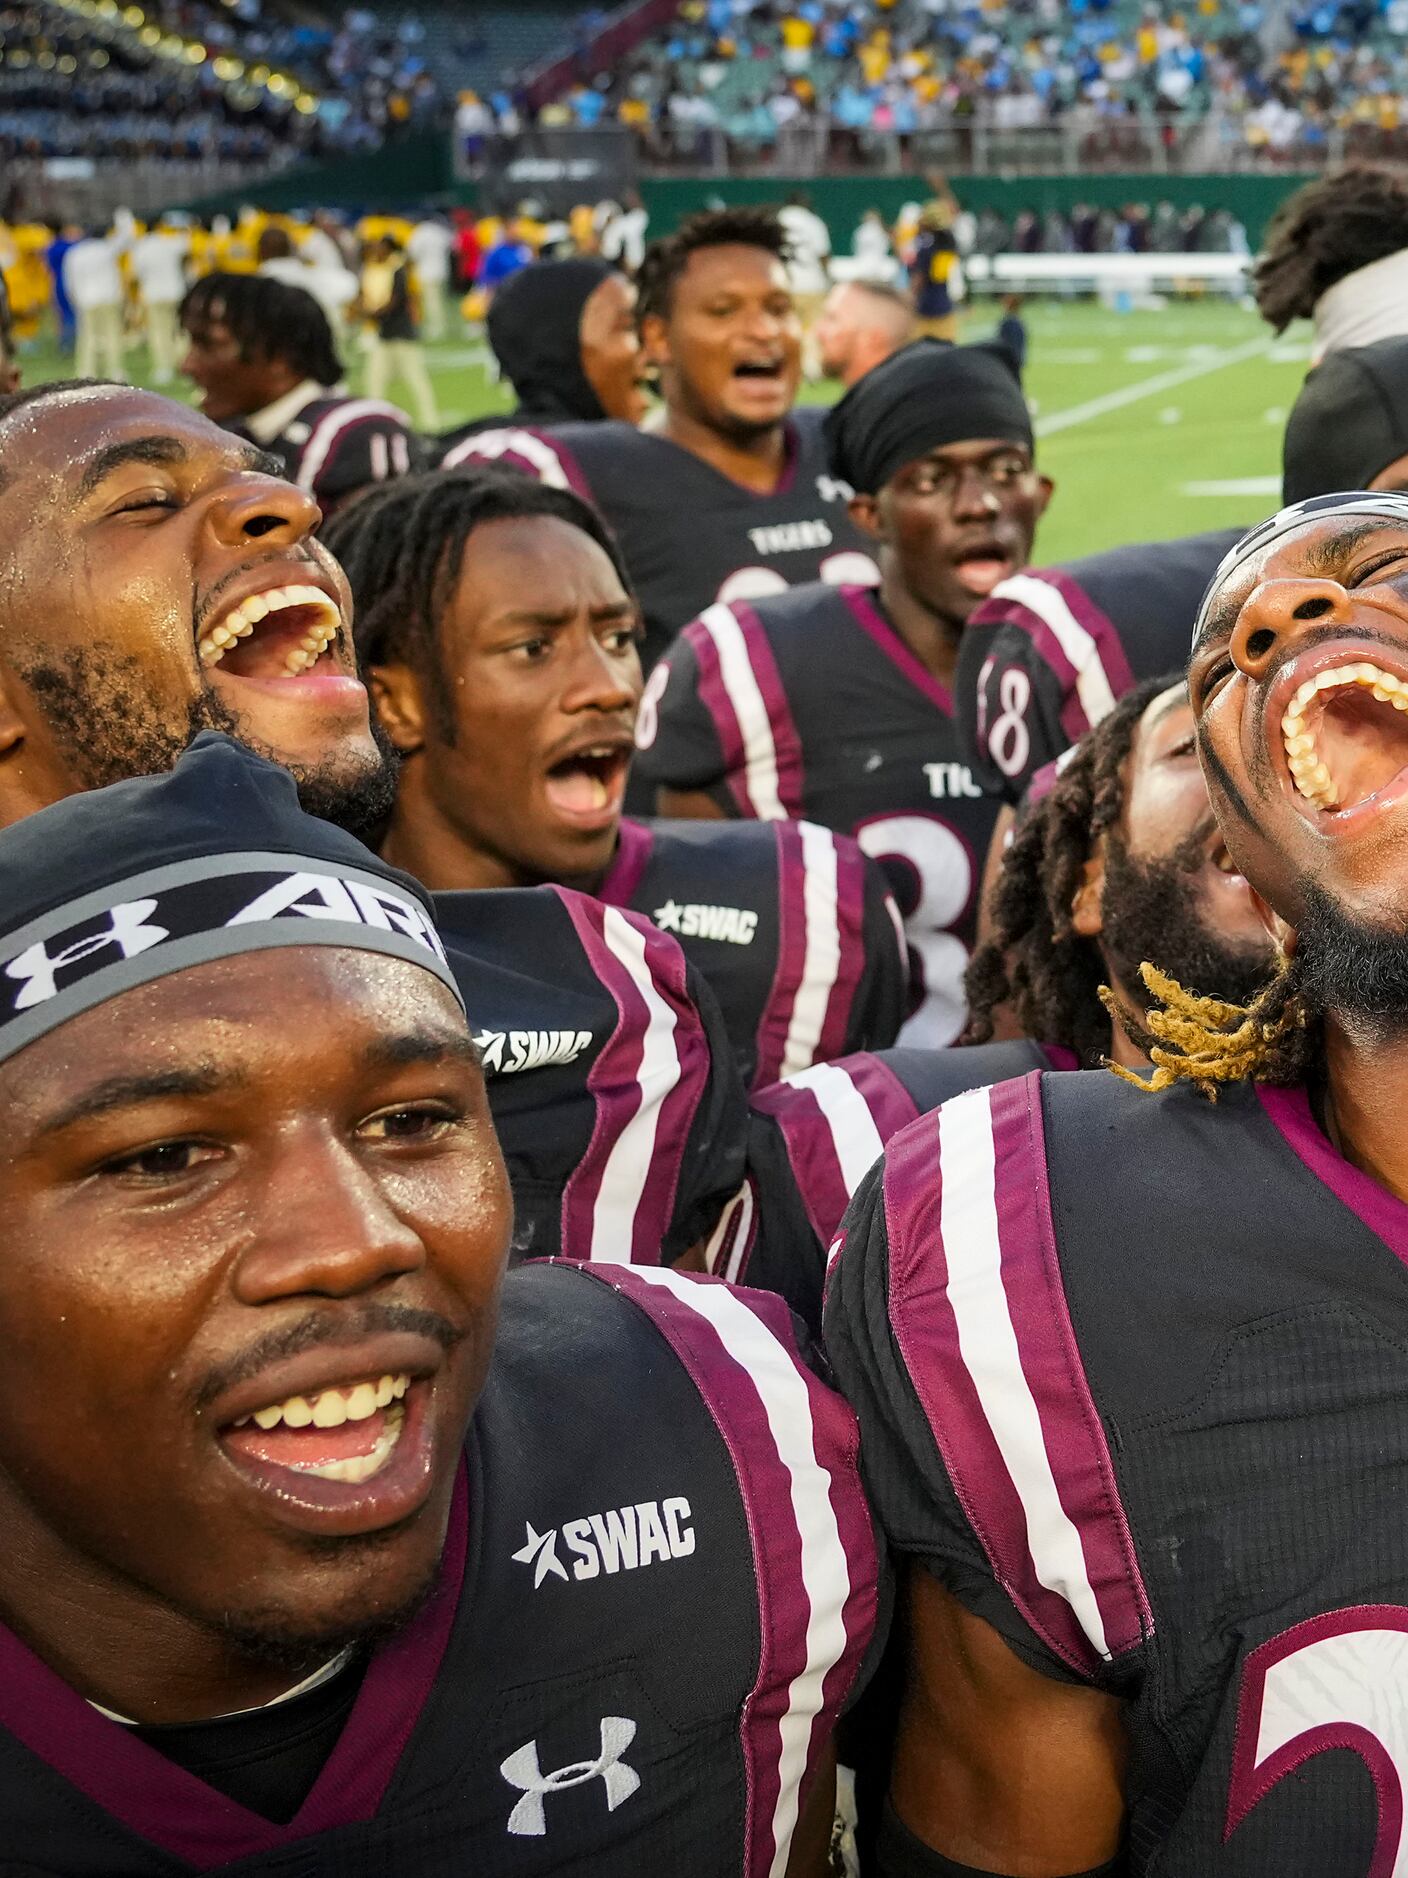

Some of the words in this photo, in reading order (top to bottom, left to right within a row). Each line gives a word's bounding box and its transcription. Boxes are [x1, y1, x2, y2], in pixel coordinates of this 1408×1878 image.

[748, 518, 834, 556] TIGERS
[680, 903, 758, 946] SWAC
[507, 1030, 593, 1073] SWAC
[562, 1496, 696, 1581] SWAC
